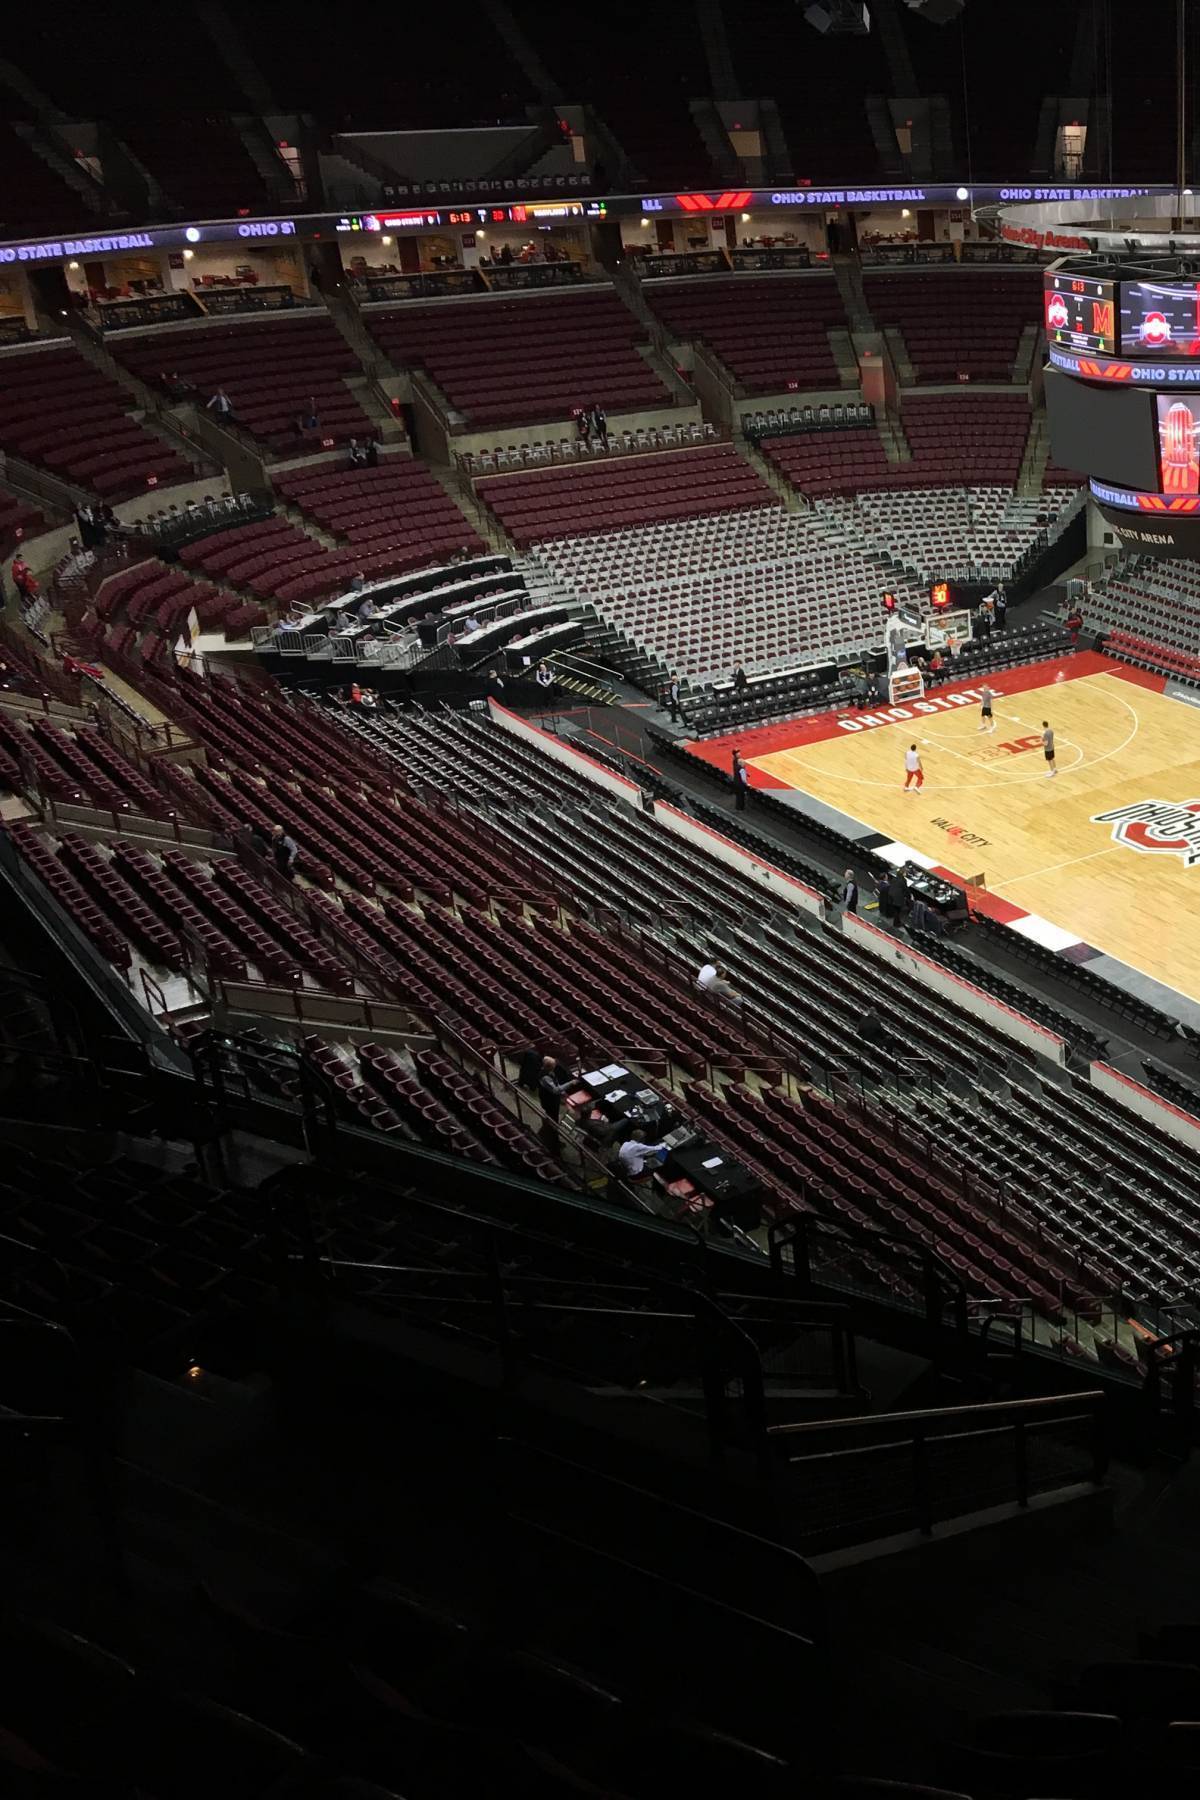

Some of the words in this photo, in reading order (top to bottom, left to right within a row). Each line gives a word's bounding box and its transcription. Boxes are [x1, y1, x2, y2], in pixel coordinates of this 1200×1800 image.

[772, 193, 806, 204] OHIO
[807, 192, 847, 203] STATE
[848, 189, 925, 202] BASKETBALL
[1000, 189, 1032, 200] OHIO
[1034, 189, 1070, 200] STATE
[450, 213, 471, 224] 6:13
[238, 222, 278, 238] OHIO
[18, 243, 63, 261] STATE
[65, 234, 153, 255] BASKETBALL
[1131, 367, 1165, 380] OHIO
[1092, 483, 1139, 507] BASKETBALL
[1141, 531, 1175, 545] ARENA
[837, 708, 914, 732] OHIO
[913, 684, 1004, 713] STATE
[930, 817, 968, 836] VALUE
[960, 833, 993, 848] CITY
